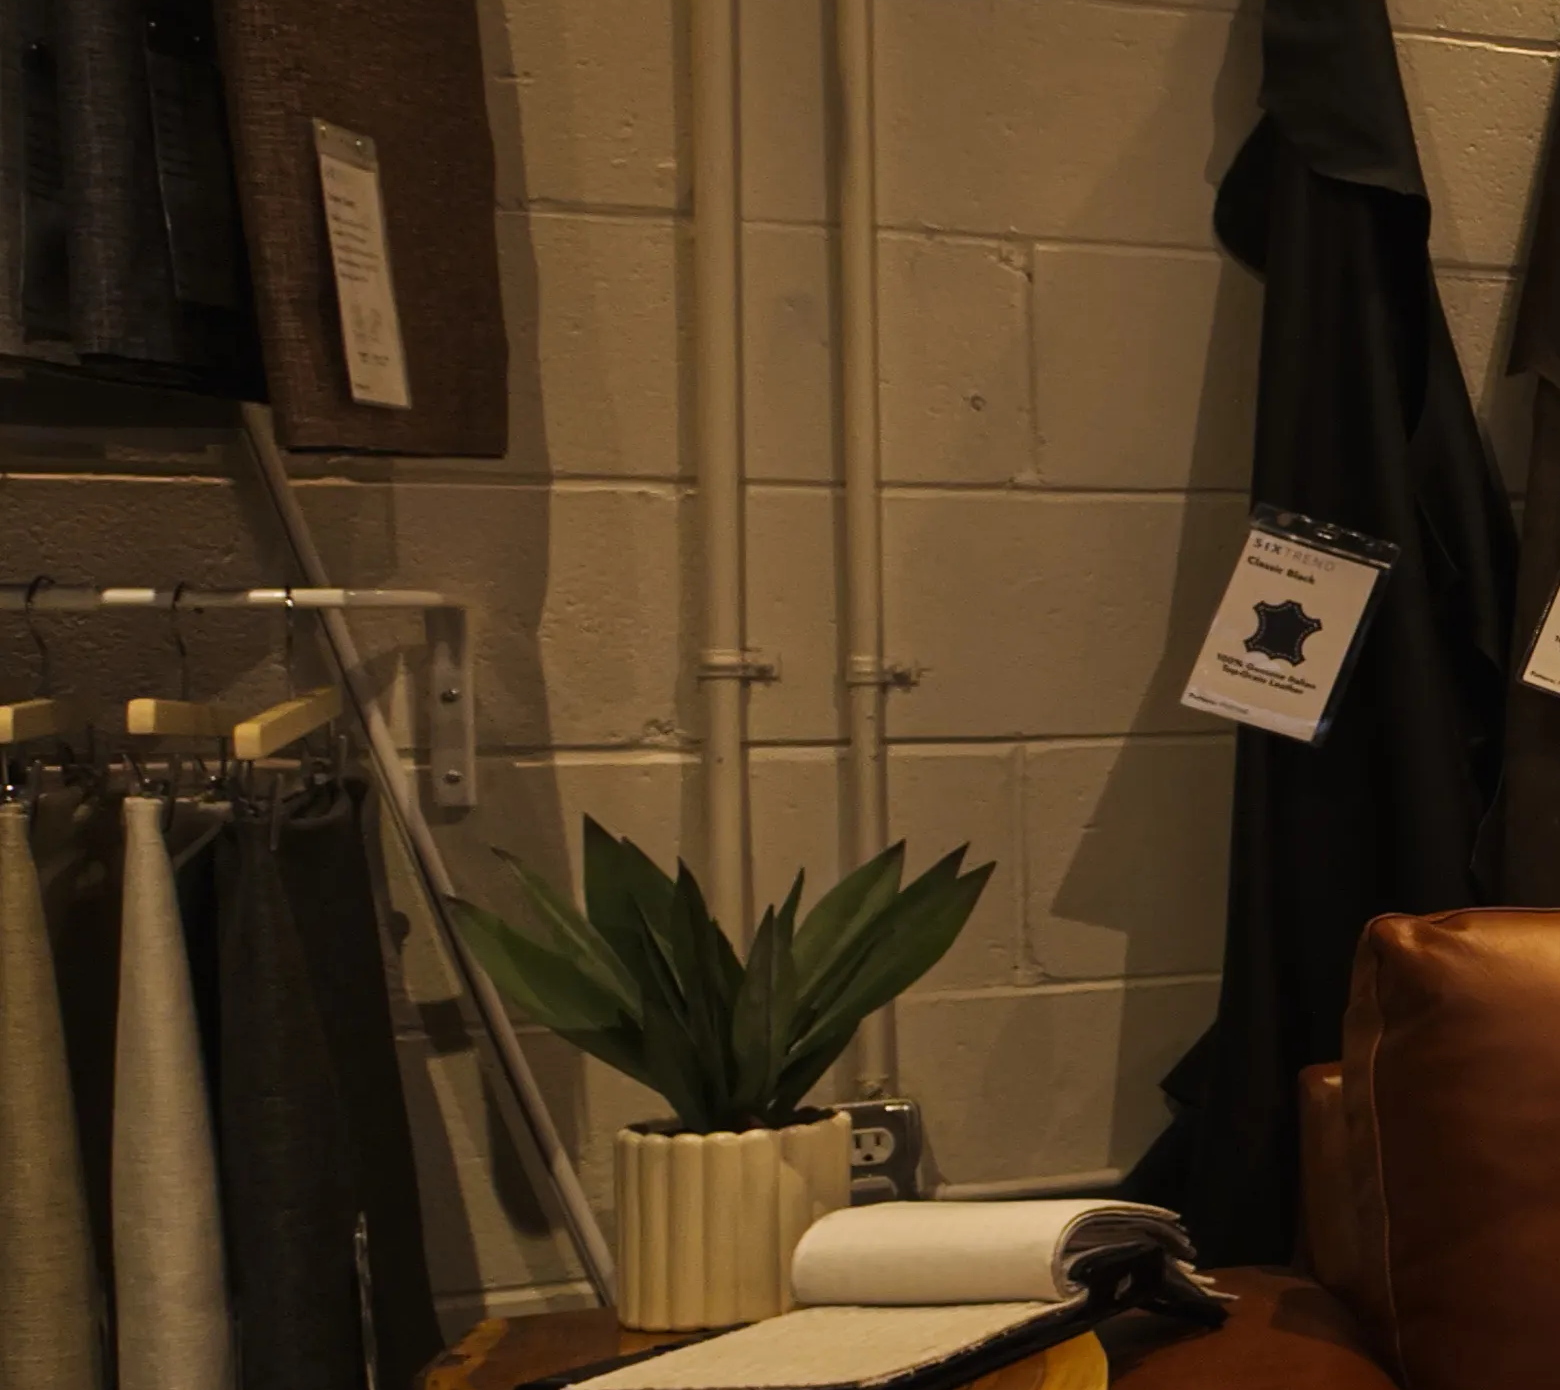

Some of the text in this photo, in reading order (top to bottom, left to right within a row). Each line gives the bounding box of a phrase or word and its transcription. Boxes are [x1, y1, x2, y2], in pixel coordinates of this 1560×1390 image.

[1247, 555, 1316, 585] Classic Black
[1252, 537, 1336, 572] SIXTREND
